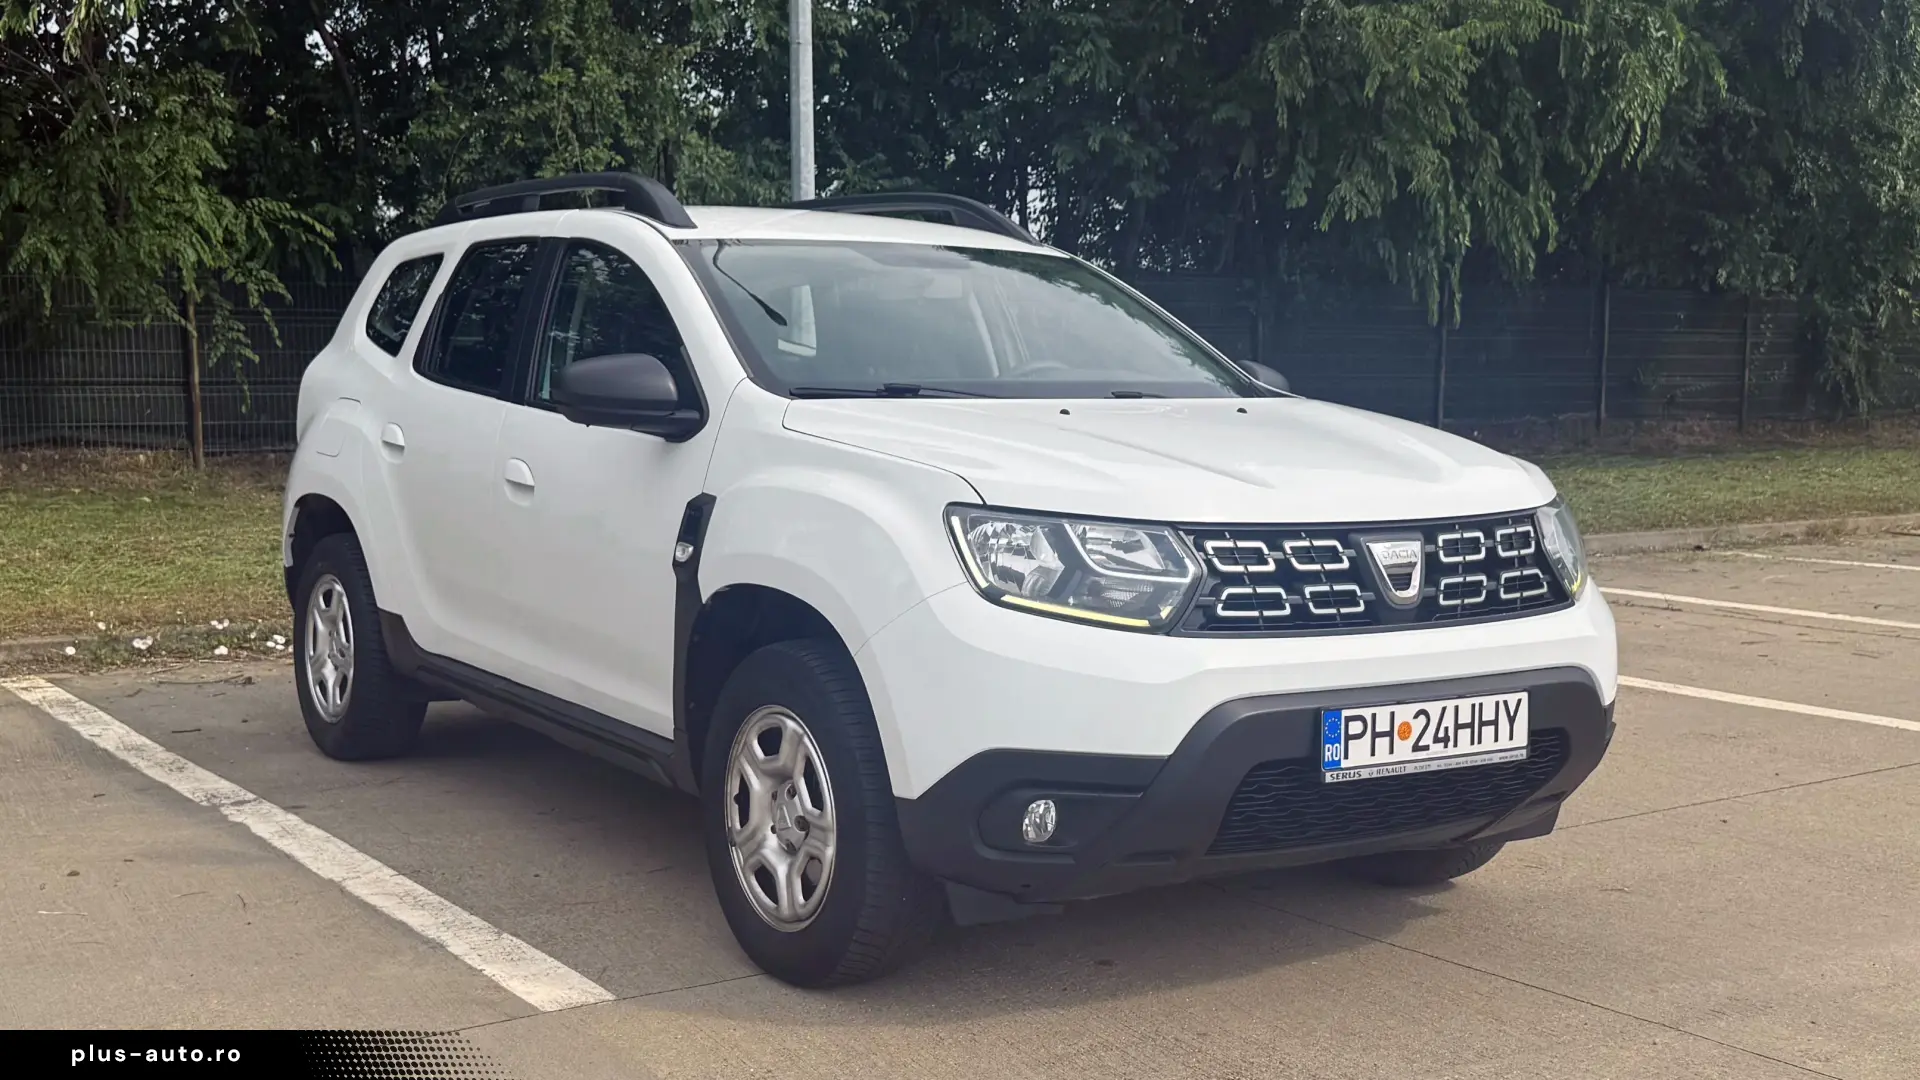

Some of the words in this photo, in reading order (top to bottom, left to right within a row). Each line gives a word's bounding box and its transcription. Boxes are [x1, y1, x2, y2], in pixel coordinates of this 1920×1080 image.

[1381, 549, 1418, 560] DACIA
[1343, 710, 1396, 760] PH
[1325, 743, 1341, 762] RO
[1329, 770, 1363, 781] SERUS
[1376, 765, 1407, 776] RENAULT
